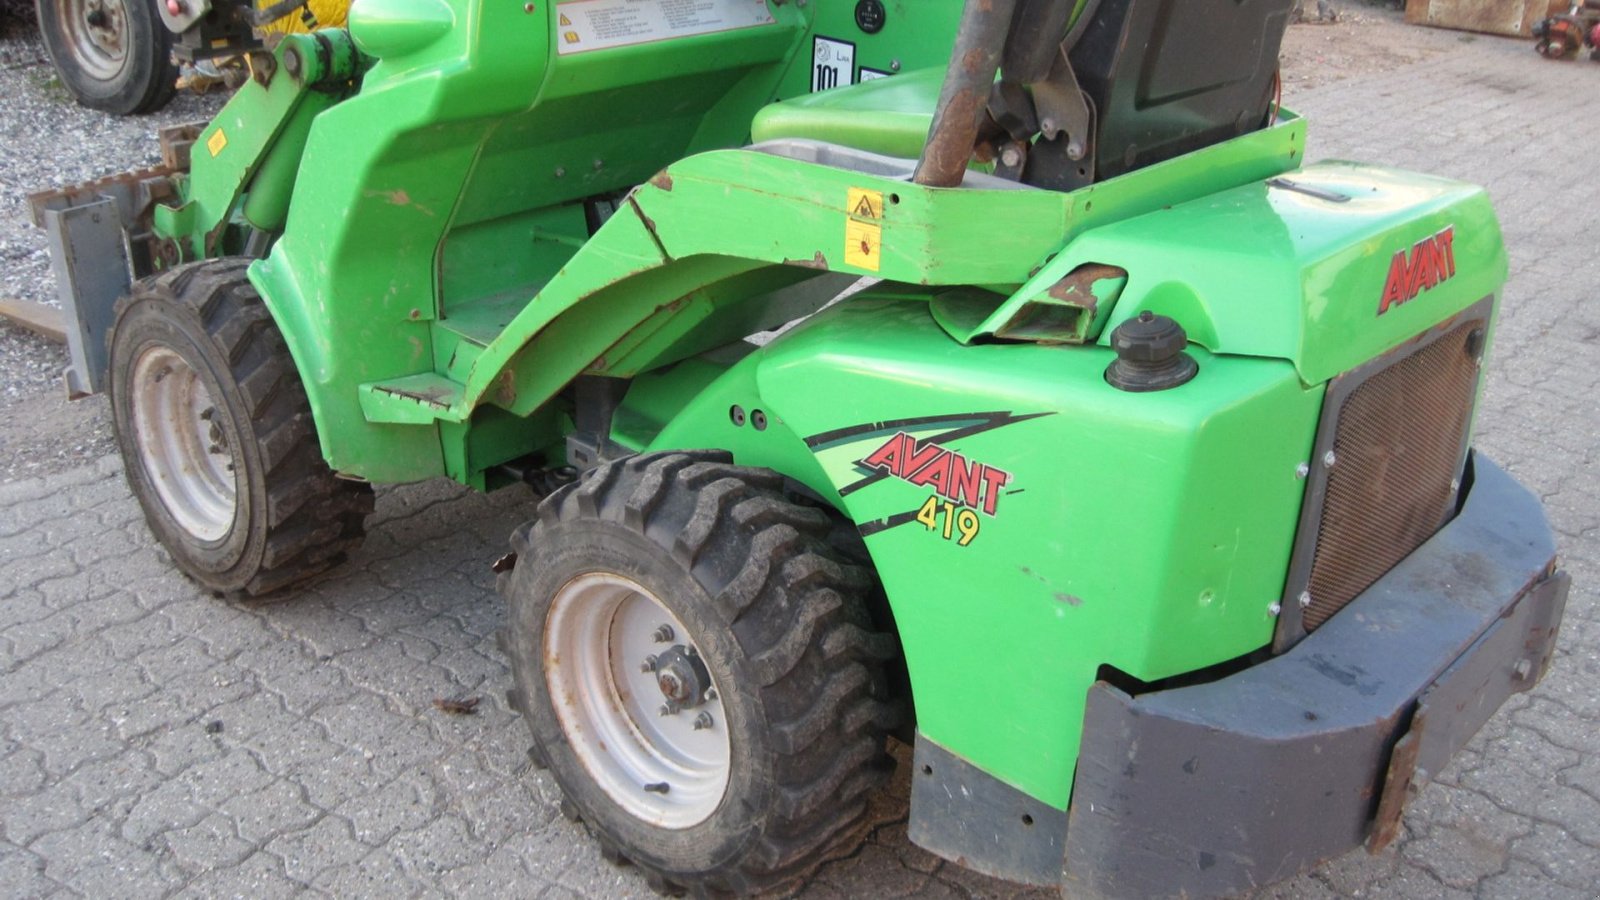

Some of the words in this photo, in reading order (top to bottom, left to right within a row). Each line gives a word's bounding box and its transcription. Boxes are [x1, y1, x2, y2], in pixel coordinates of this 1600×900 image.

[816, 64, 839, 92] 101
[1376, 225, 1455, 316] AVANT
[860, 431, 1010, 517] AVANT
[916, 495, 980, 547] 419
